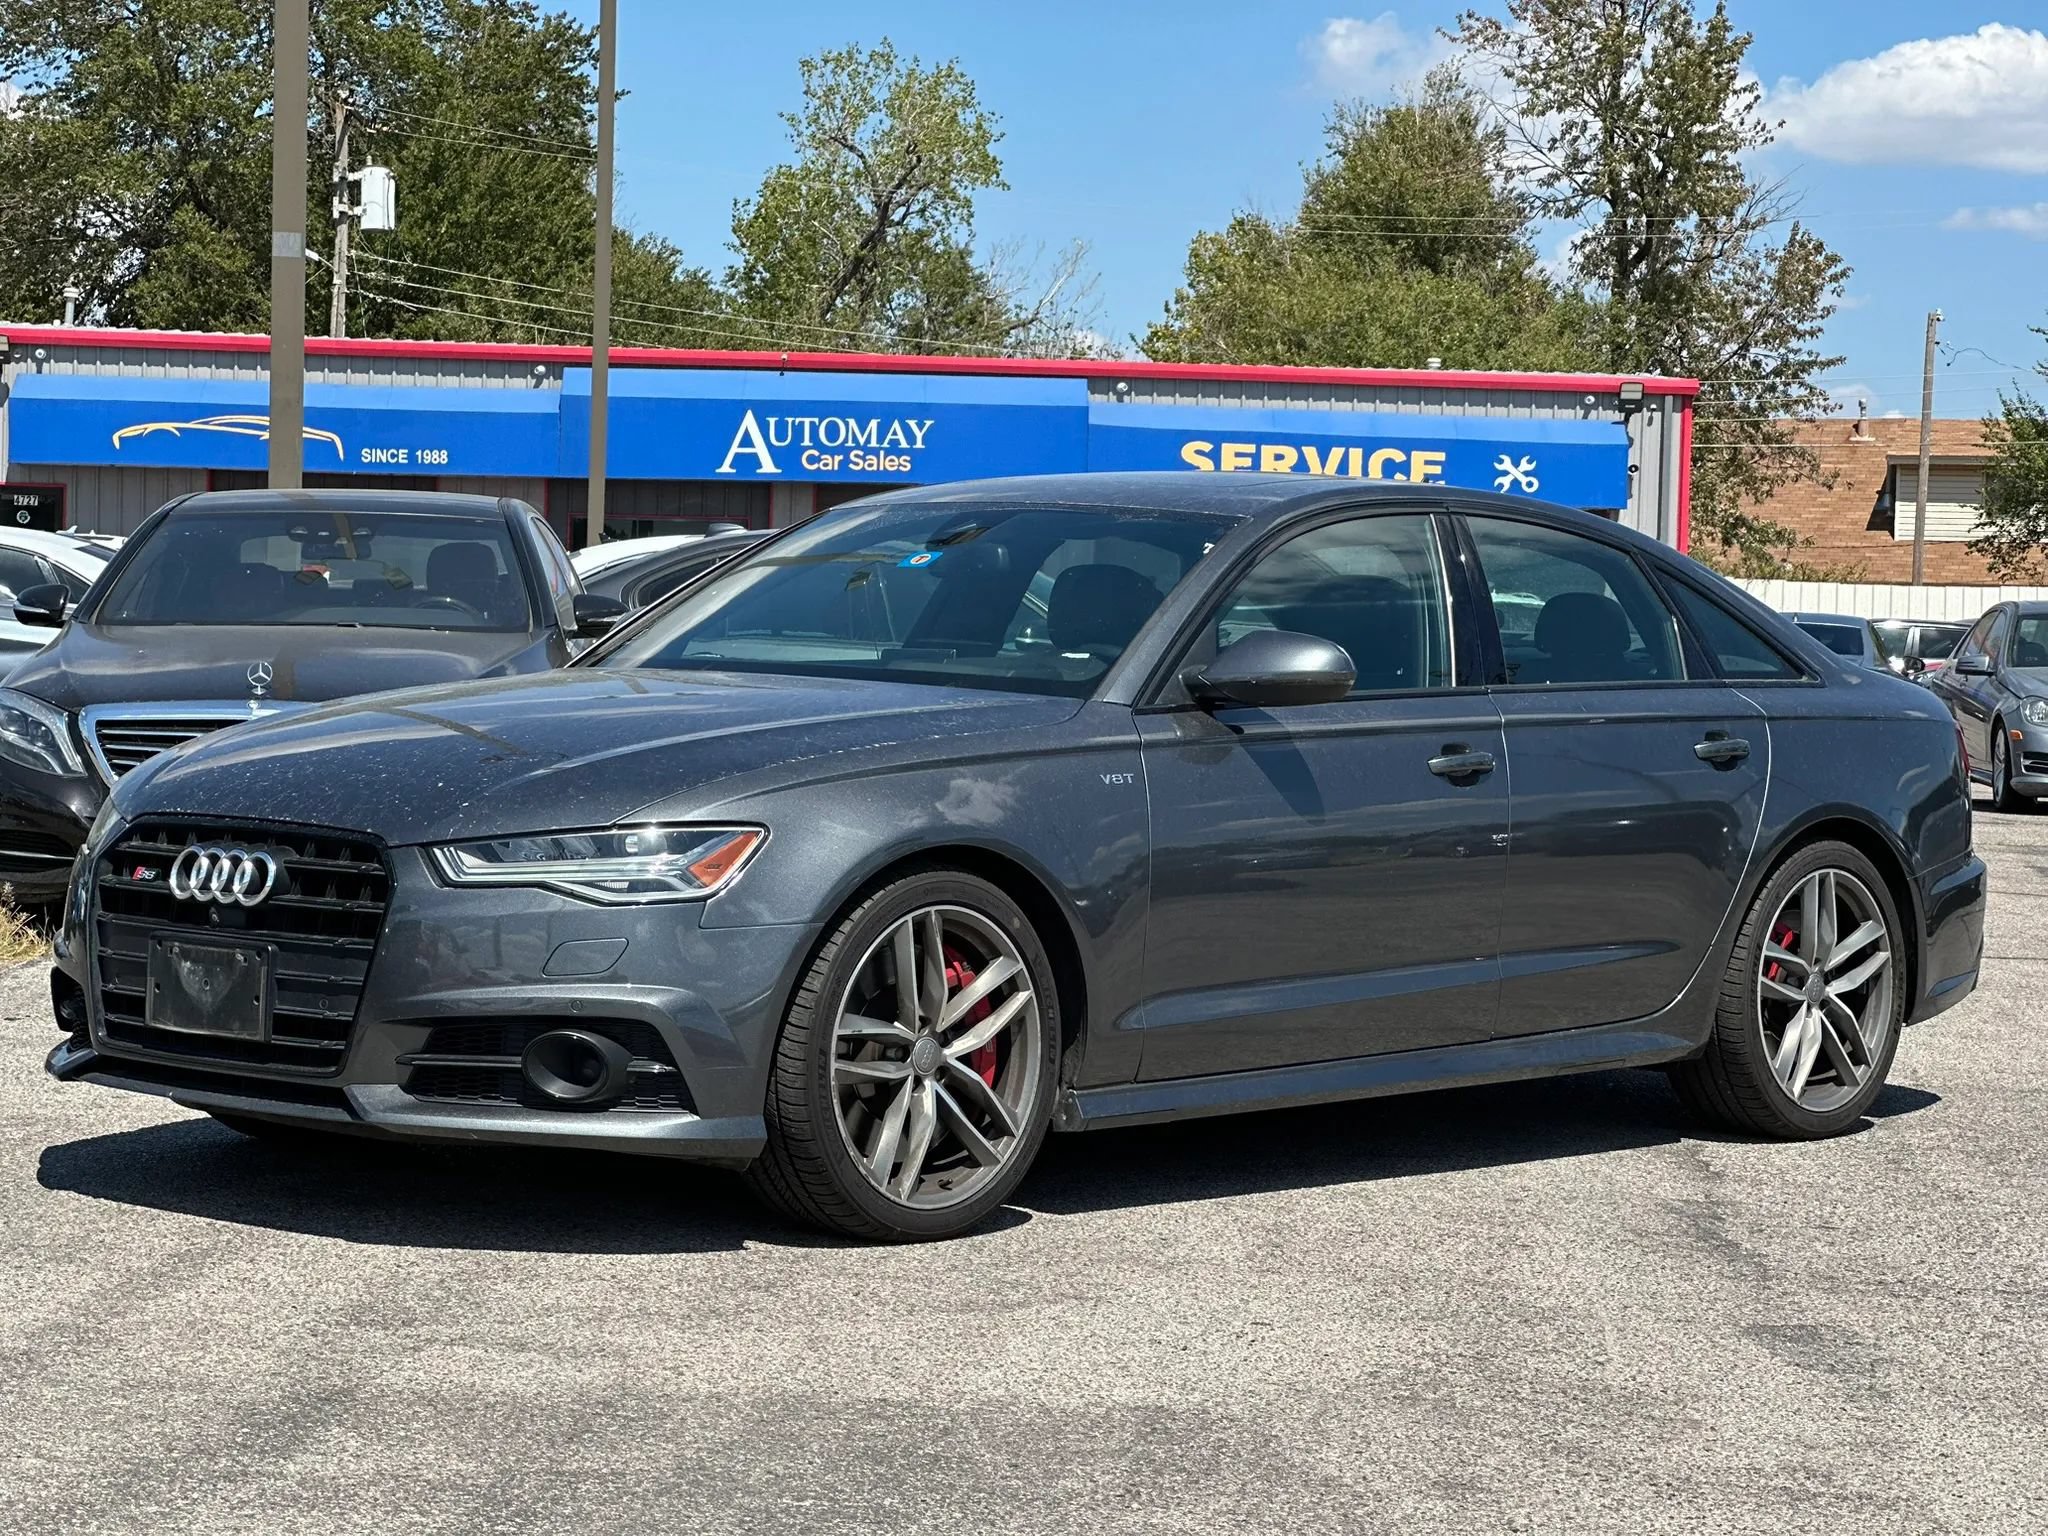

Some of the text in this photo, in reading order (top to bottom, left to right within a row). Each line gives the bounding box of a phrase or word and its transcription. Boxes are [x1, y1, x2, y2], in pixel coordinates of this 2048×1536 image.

[715, 409, 934, 473] AUTOMAY
[361, 448, 449, 464] SINCE 1988
[801, 449, 911, 472] Car Sales
[1181, 440, 1446, 485] SERVICE
[14, 495, 39, 506] 4727
[1099, 773, 1134, 785] V8T
